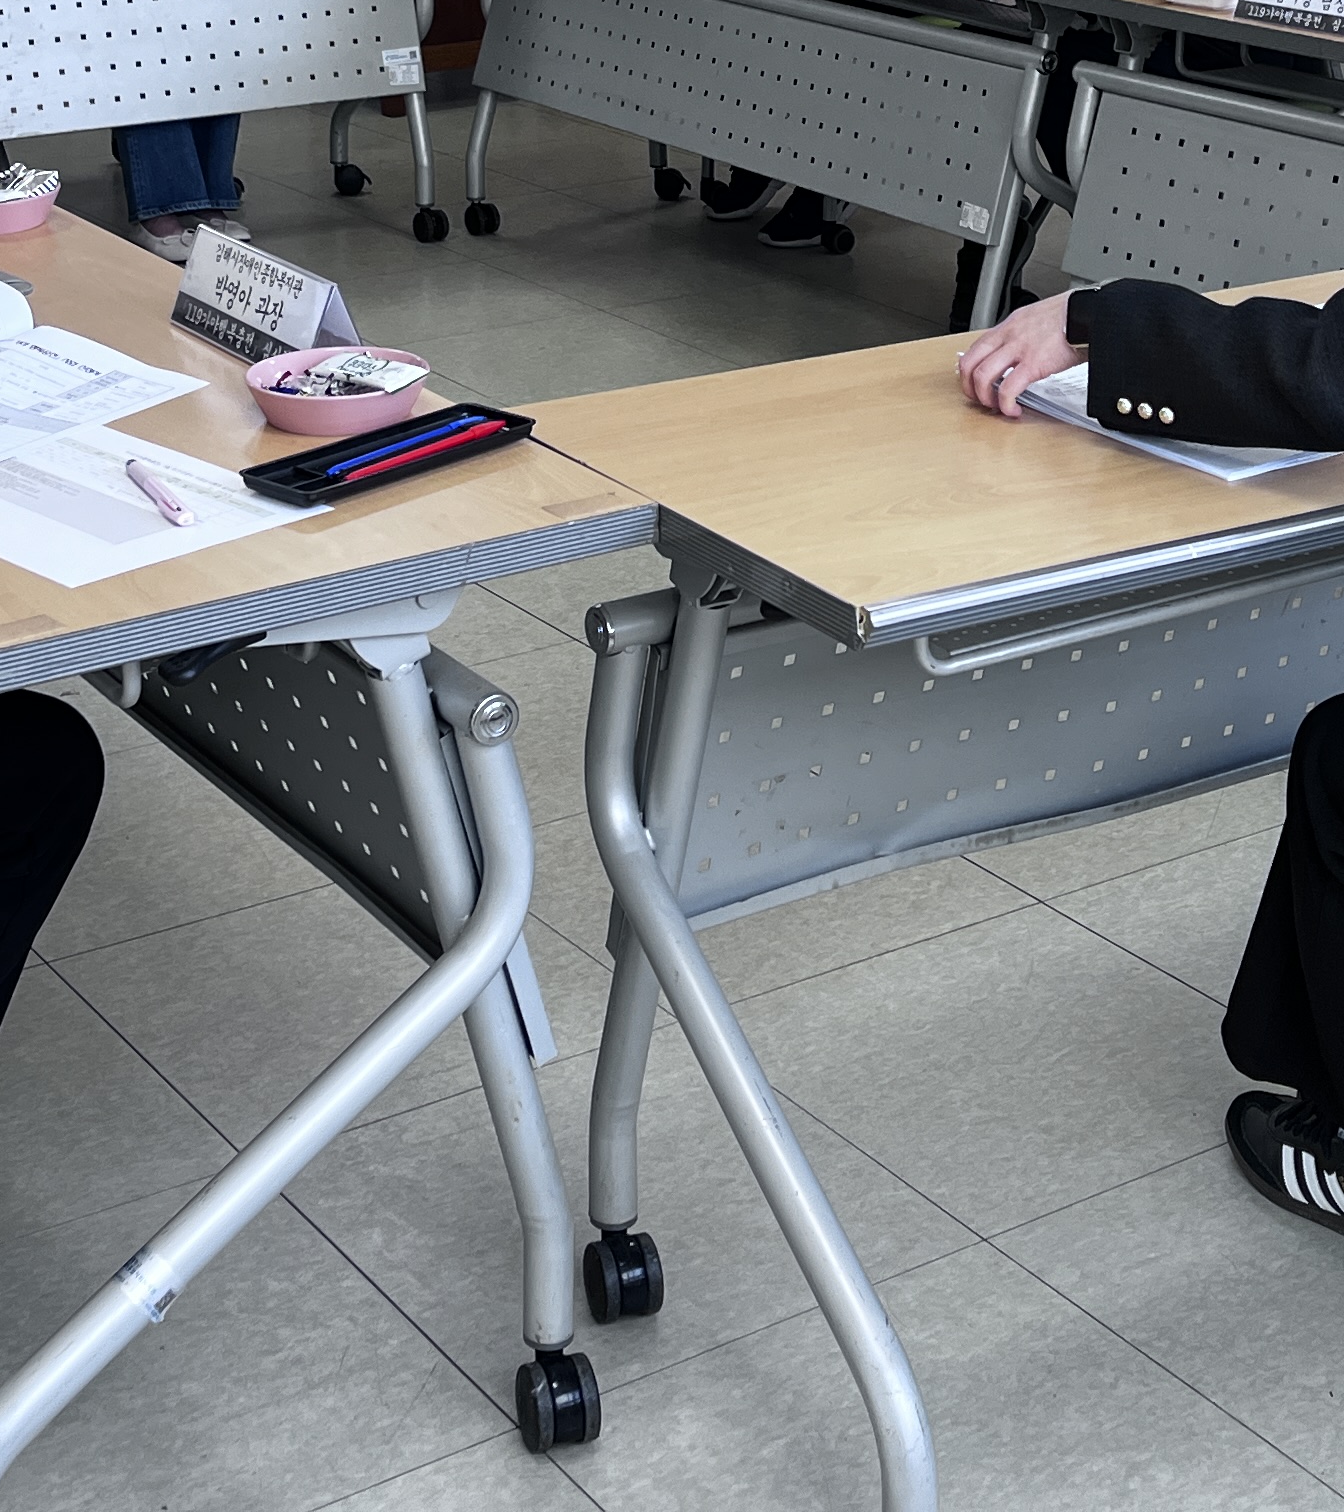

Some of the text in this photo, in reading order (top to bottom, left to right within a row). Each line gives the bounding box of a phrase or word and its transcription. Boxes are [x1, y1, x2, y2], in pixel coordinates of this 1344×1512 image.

[215, 243, 304, 299] 김해시장애인종합복지관
[215, 275, 284, 331] 박영아 과장
